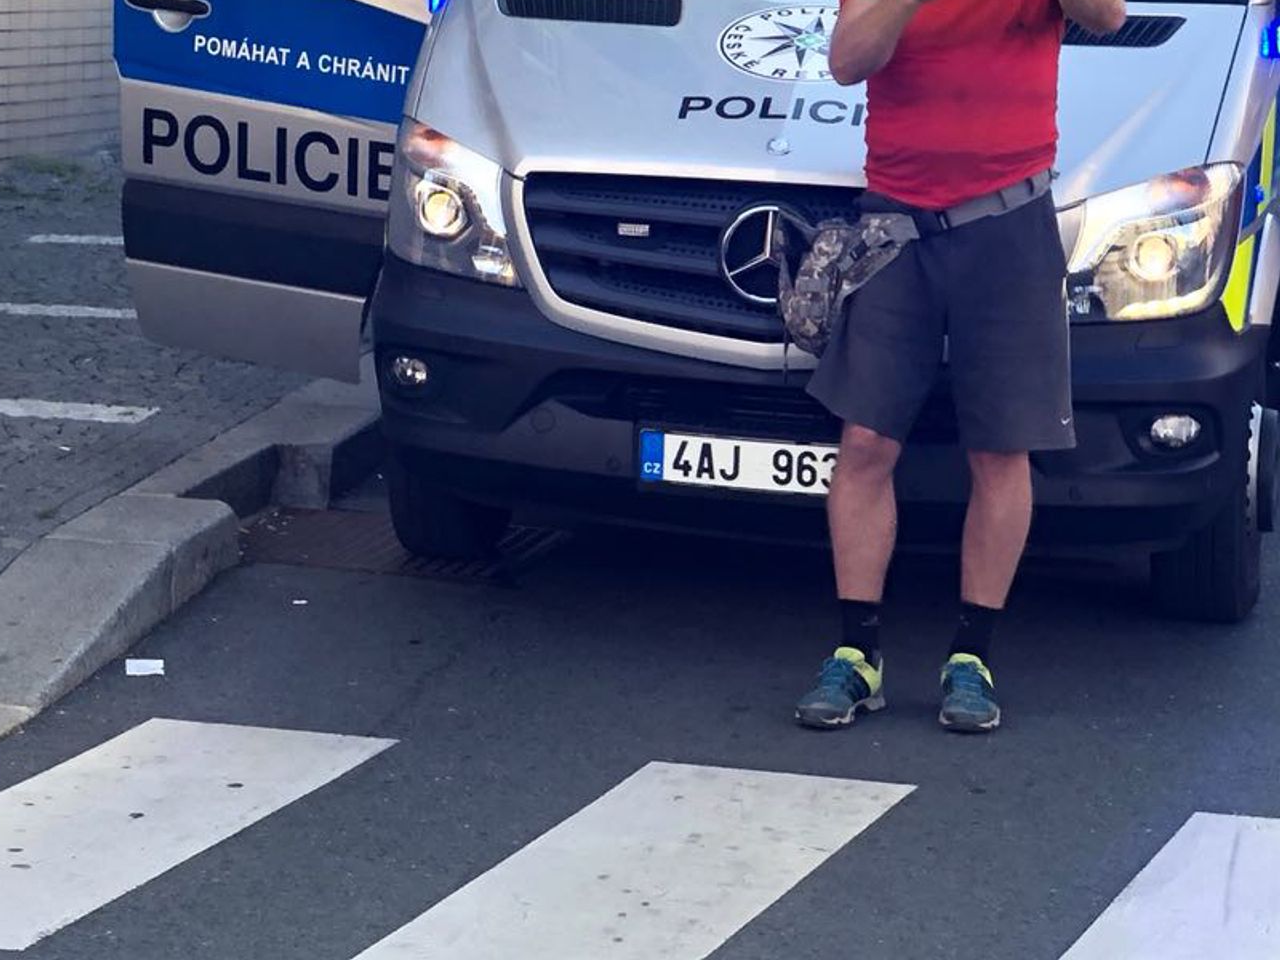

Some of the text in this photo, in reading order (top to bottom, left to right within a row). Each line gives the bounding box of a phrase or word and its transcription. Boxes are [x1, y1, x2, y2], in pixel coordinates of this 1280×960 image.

[194, 34, 410, 85] POMÁHAT A CHRÁNIT
[771, 68, 832, 79] REP
[678, 95, 865, 127] POLICI
[142, 107, 397, 201] POLICIE
[643, 462, 662, 475] CZ
[672, 440, 839, 488] 4AJ 963
